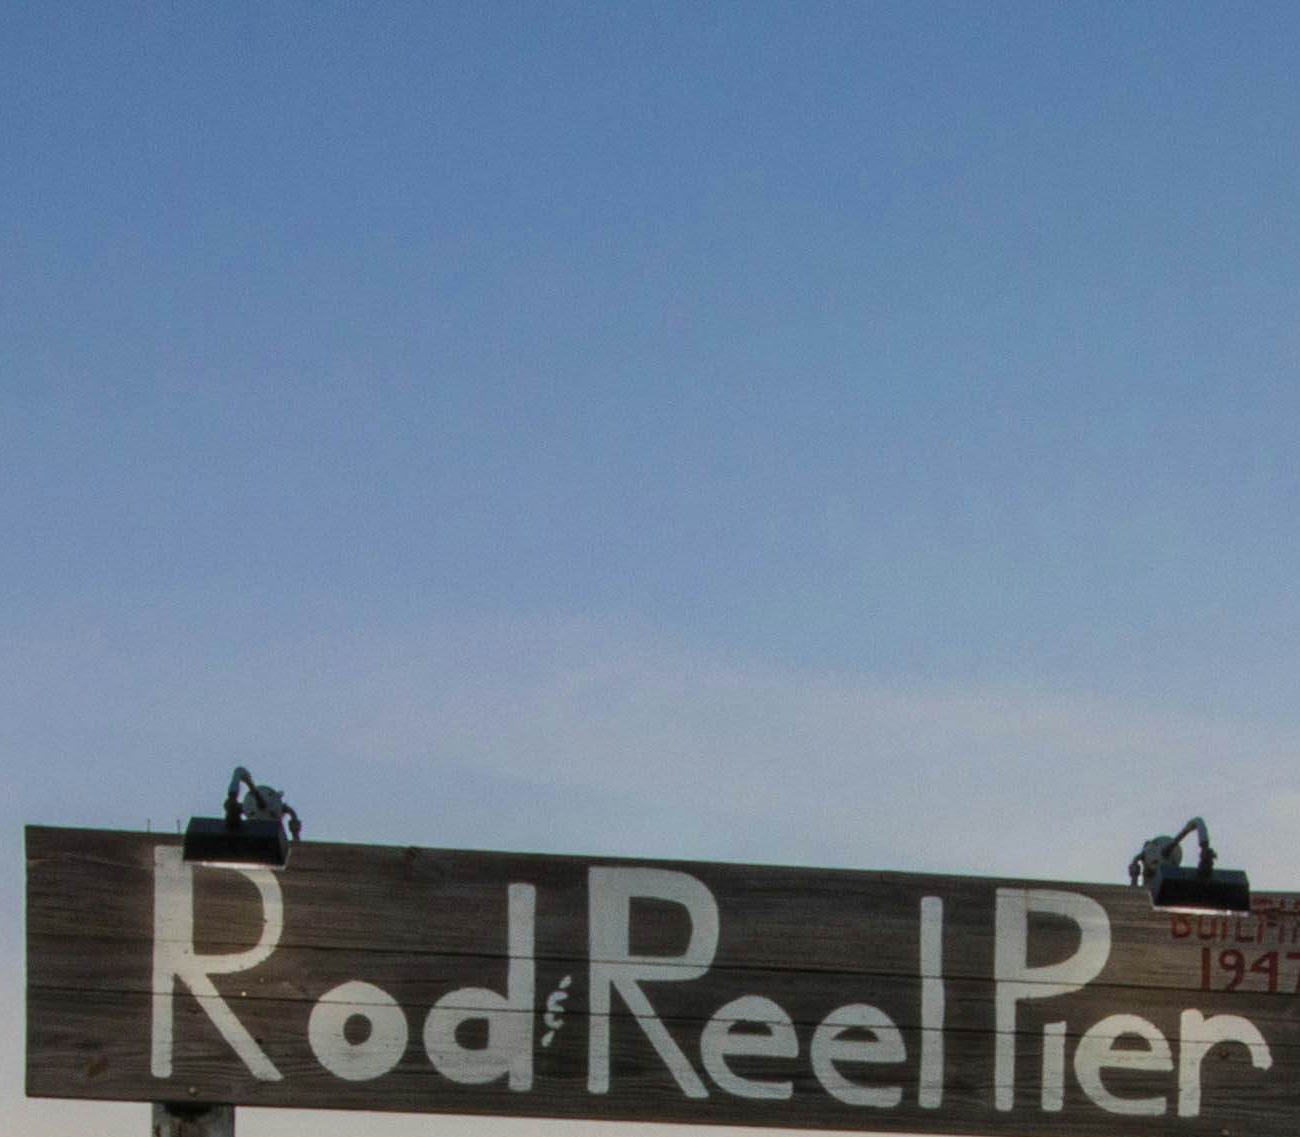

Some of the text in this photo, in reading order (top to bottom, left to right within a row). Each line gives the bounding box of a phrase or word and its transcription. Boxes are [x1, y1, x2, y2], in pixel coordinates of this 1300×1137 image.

[151, 845, 535, 1092] Rod
[588, 866, 944, 1109] Reel
[995, 887, 1273, 1118] Pier
